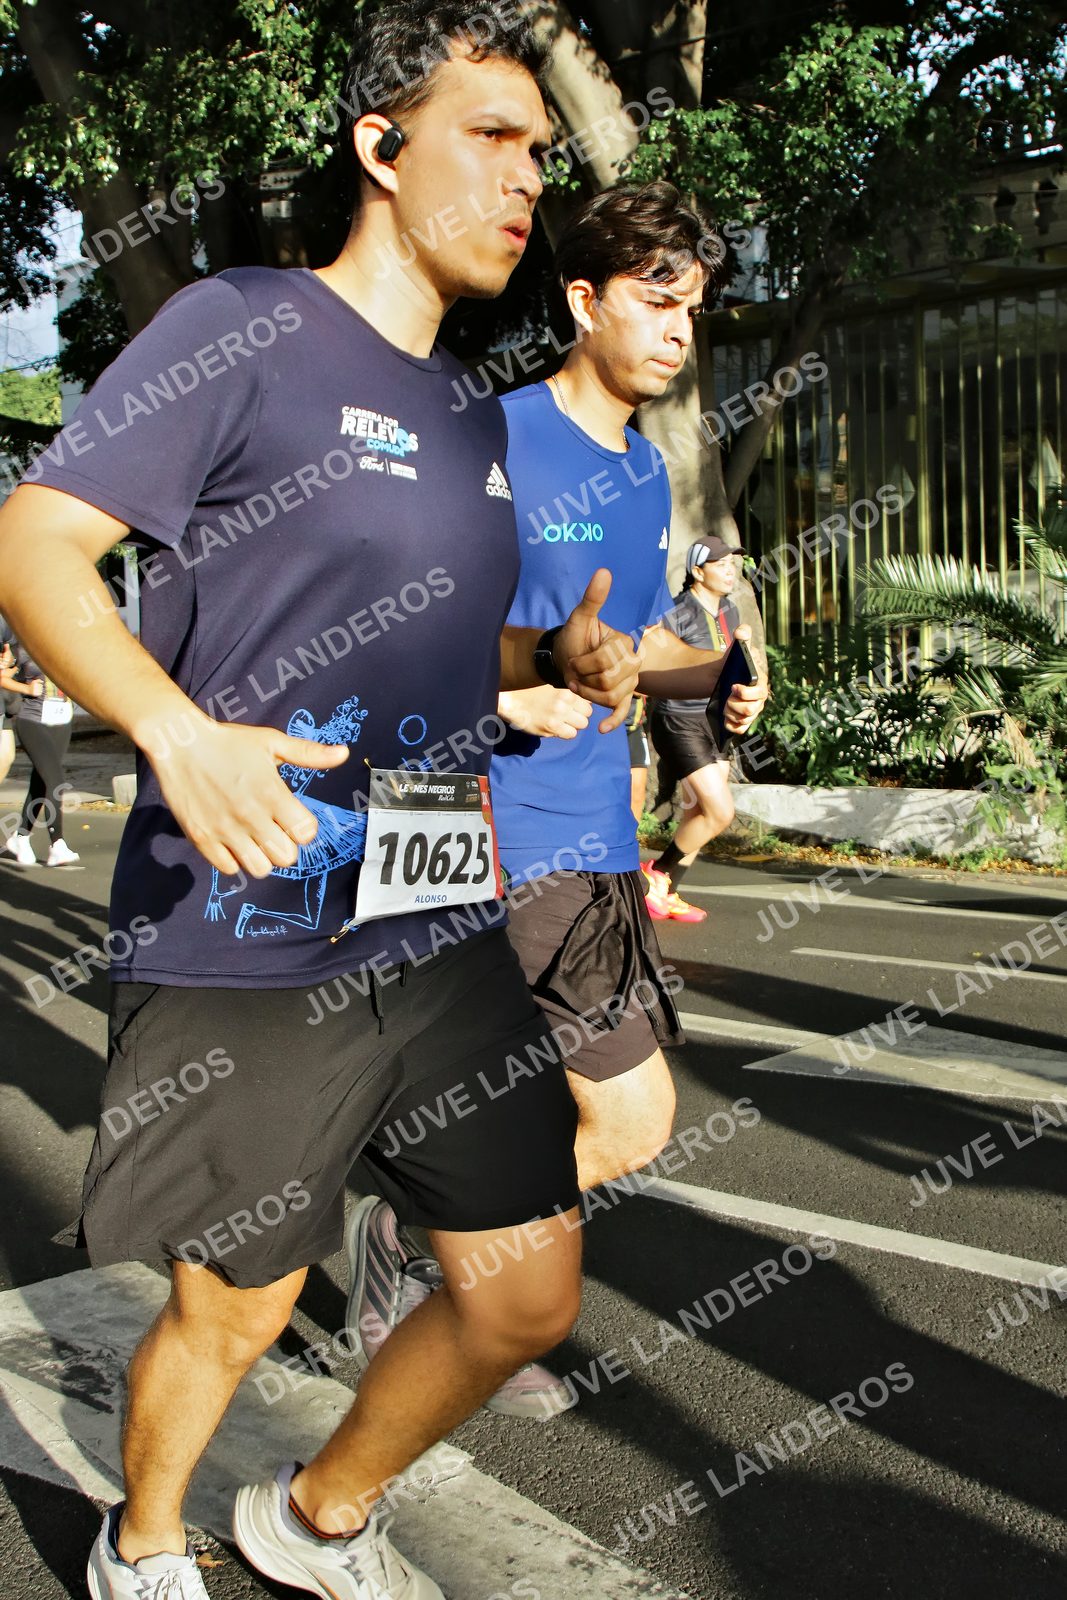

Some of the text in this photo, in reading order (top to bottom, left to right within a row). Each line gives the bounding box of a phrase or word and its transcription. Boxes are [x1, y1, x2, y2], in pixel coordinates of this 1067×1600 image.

[341, 405, 399, 429] CARRERA POR
[340, 413, 419, 452] RELEVOS
[359, 455, 385, 473] Ford
[428, 785, 456, 795] NEGROS
[378, 831, 490, 886] 10625
[415, 894, 448, 903] ALONSO
